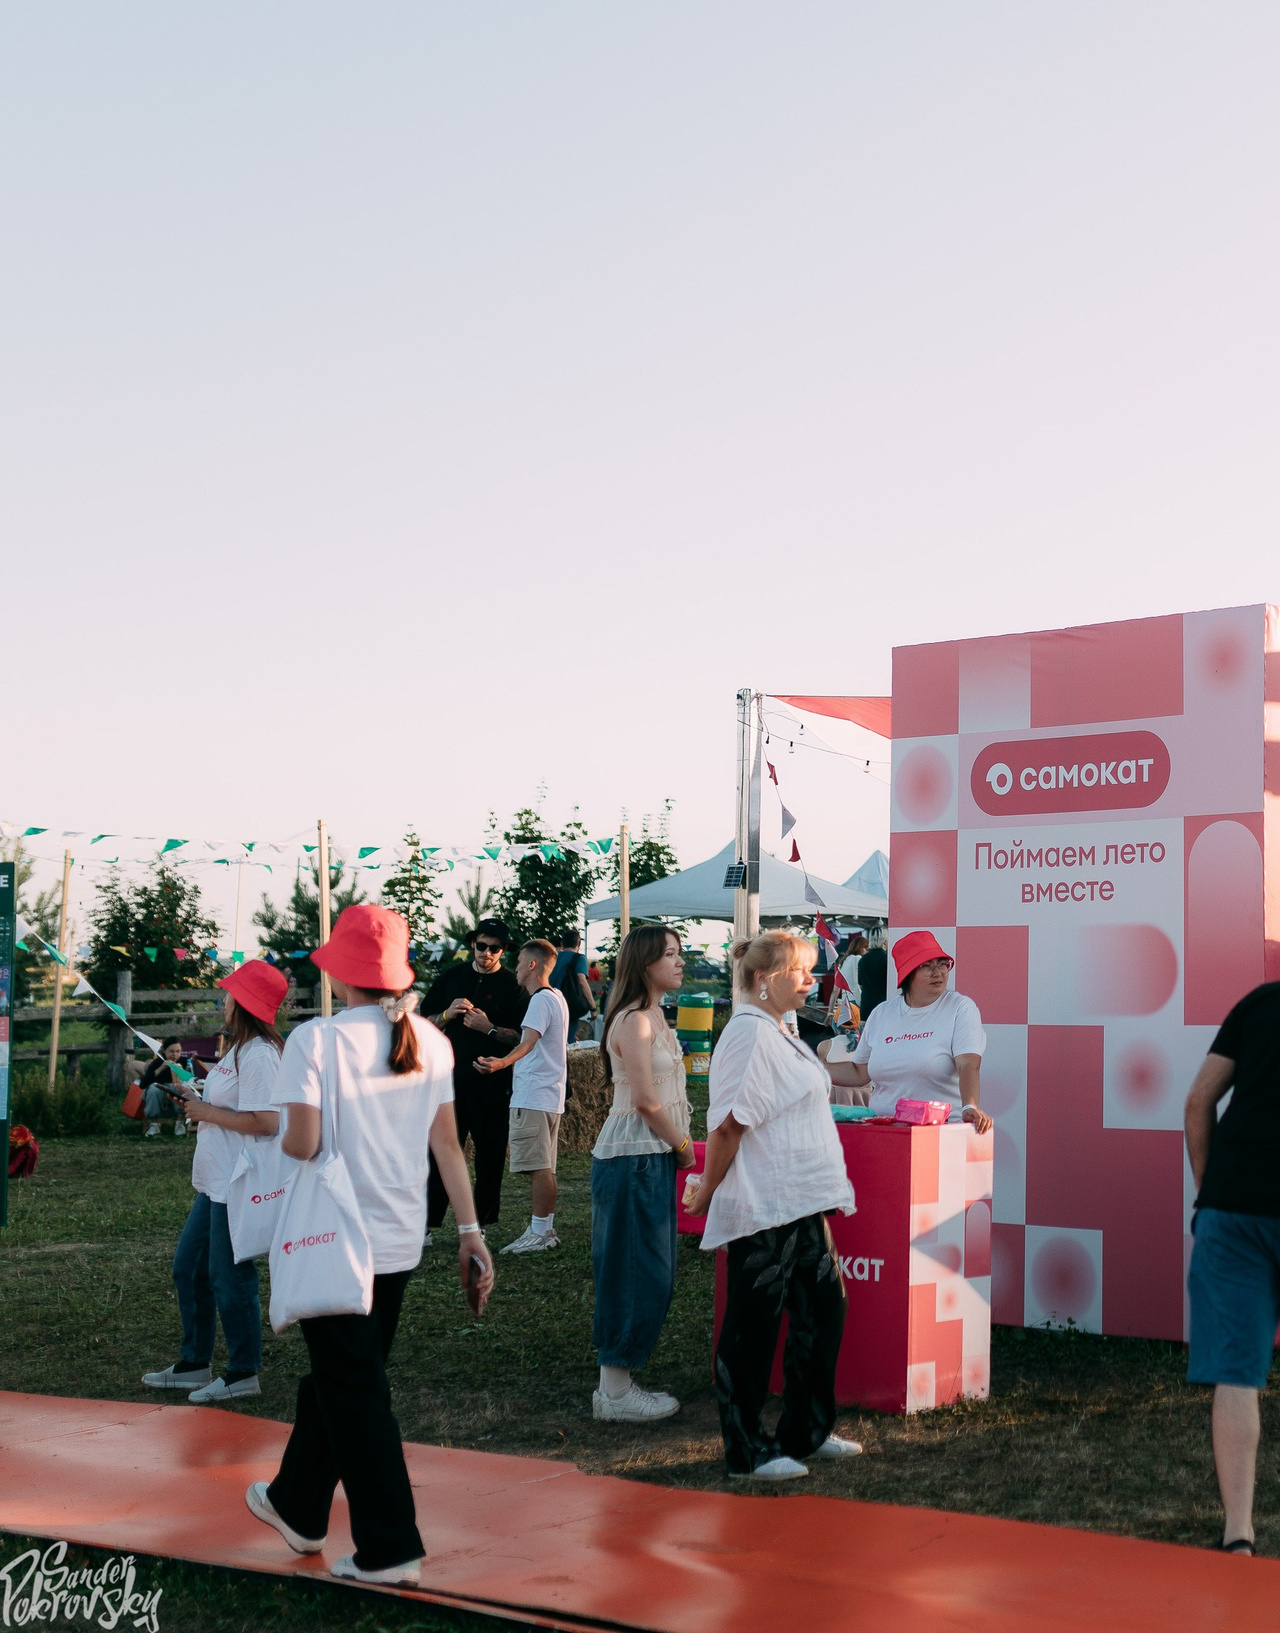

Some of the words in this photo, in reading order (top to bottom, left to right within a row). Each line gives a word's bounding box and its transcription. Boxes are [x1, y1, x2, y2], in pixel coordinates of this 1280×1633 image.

[1019, 757, 1155, 791] самокат
[974, 838, 1097, 870] Поймаем
[1102, 841, 1167, 866] лето
[1021, 878, 1116, 903] вместе
